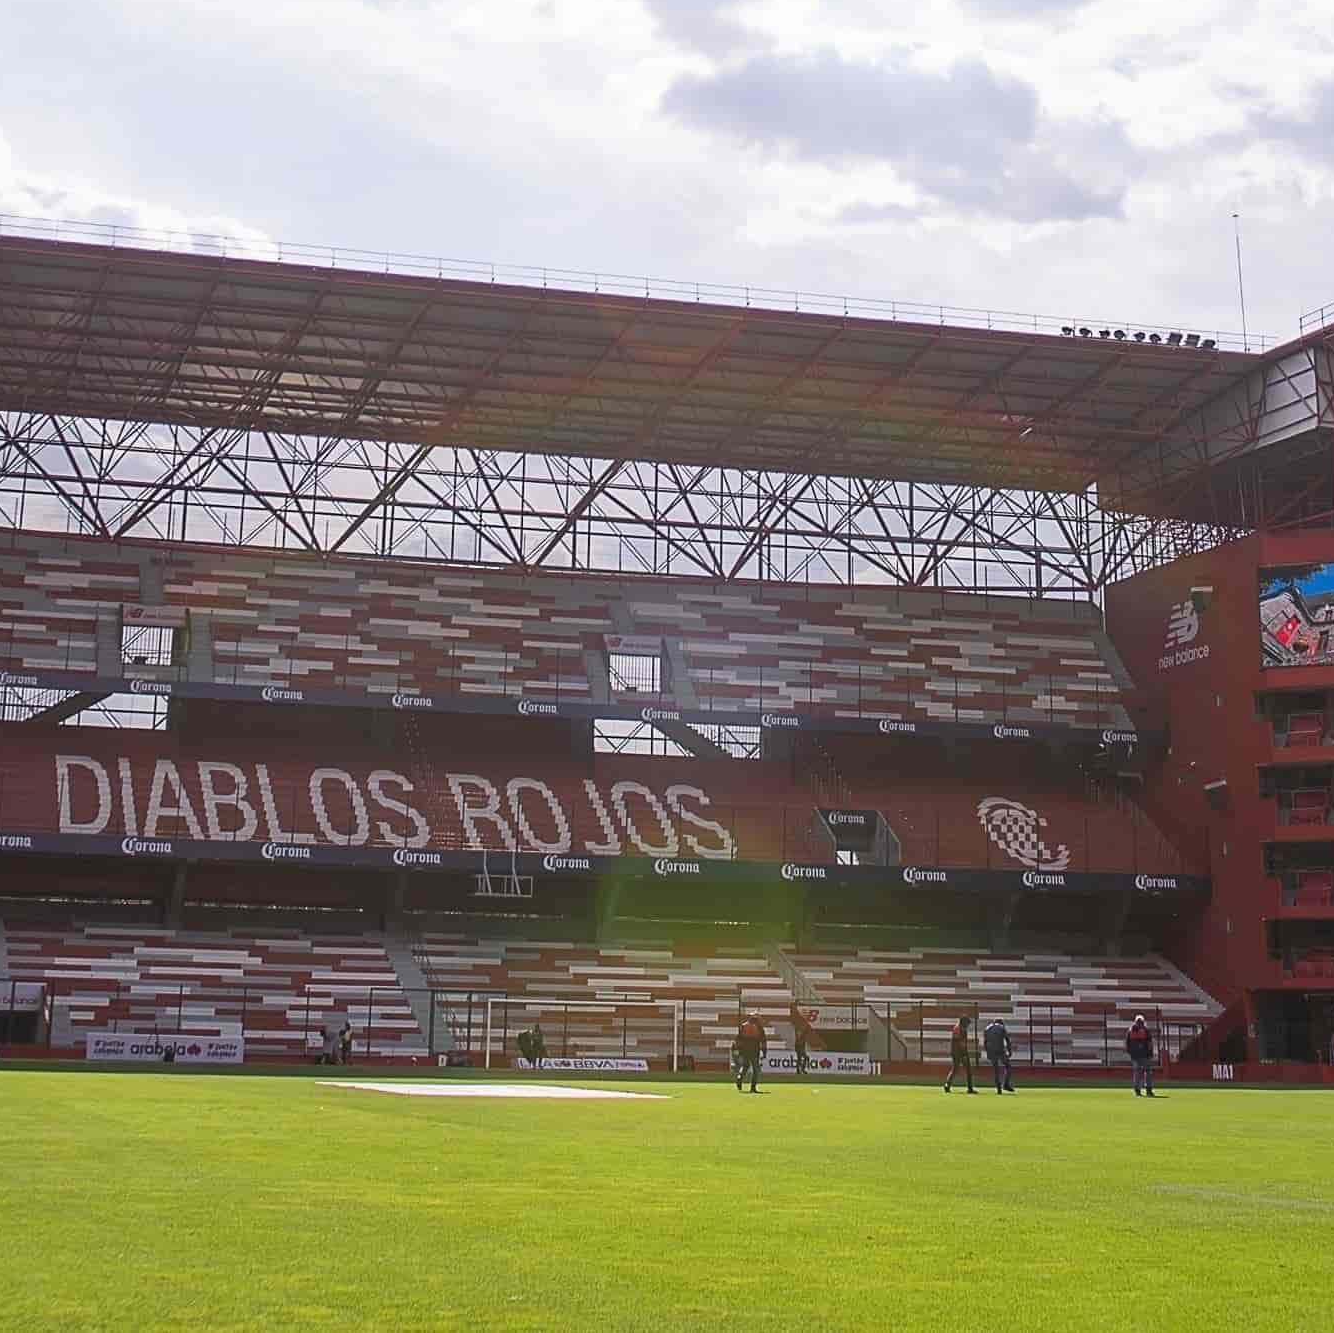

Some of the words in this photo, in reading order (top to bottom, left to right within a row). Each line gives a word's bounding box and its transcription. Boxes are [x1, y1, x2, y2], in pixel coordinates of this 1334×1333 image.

[130, 679, 172, 693] Corona
[262, 687, 303, 702] Corona
[392, 693, 433, 709] Corona
[518, 699, 558, 715] Corona
[641, 707, 680, 722] Corona
[762, 712, 799, 727] Corona
[879, 718, 916, 733] Corona
[994, 724, 1029, 739] Corona
[1102, 730, 1138, 744] Corona
[54, 754, 432, 849] DIABLOS
[447, 772, 738, 859] ROJOS
[828, 810, 866, 825] Corona
[122, 836, 172, 856] Corona
[261, 843, 311, 861] Corona
[393, 848, 441, 866] Corona
[543, 854, 591, 872] Corona
[654, 859, 701, 875] Corona
[781, 863, 827, 881] Corona
[903, 867, 947, 884] Corona
[1022, 871, 1066, 888] Corona
[1134, 875, 1177, 891] Corona
